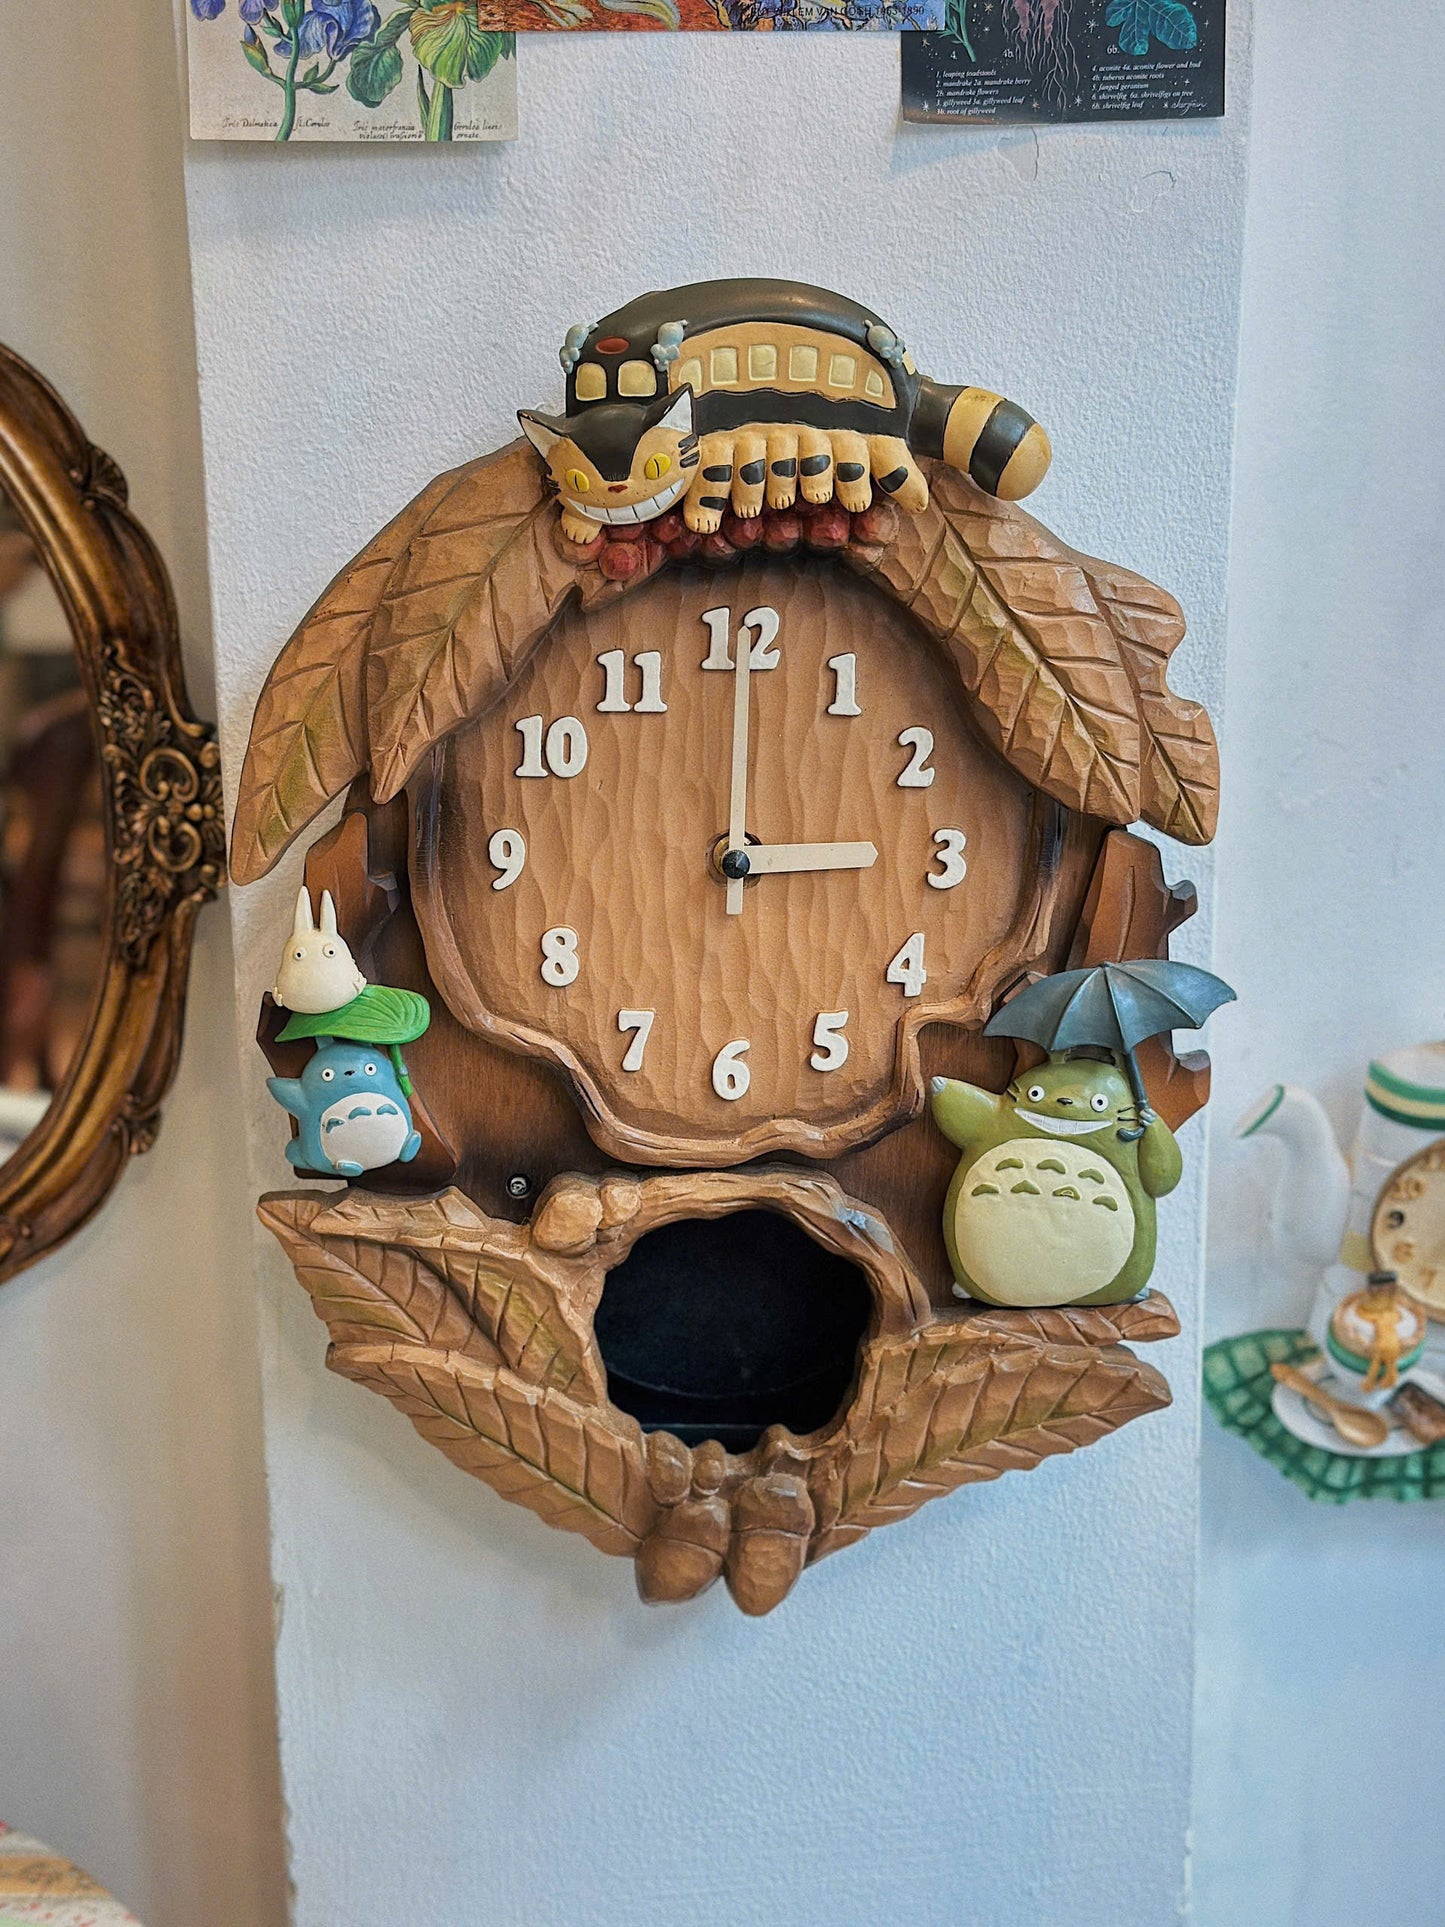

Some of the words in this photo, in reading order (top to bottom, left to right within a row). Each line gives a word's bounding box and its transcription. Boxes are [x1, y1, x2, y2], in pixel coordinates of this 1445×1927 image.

[1106, 44, 1120, 54] 6b.
[1176, 61, 1188, 69] and
[943, 79, 972, 87] mandrake
[984, 78, 1013, 86] mandrake
[1014, 77, 1031, 86] berry
[946, 88, 976, 96] mandrake
[976, 88, 999, 97] flowers
[701, 606, 781, 670] 12
[597, 649, 668, 713] 11
[827, 652, 863, 717] 1
[514, 715, 588, 778] 10
[896, 726, 935, 788] 2
[488, 828, 526, 891] 9
[926, 828, 968, 890] 3
[540, 925, 580, 987] 8
[886, 931, 927, 998] 4
[617, 1008, 656, 1072] 7
[712, 1039, 751, 1101] 6
[810, 1010, 850, 1072] 5
